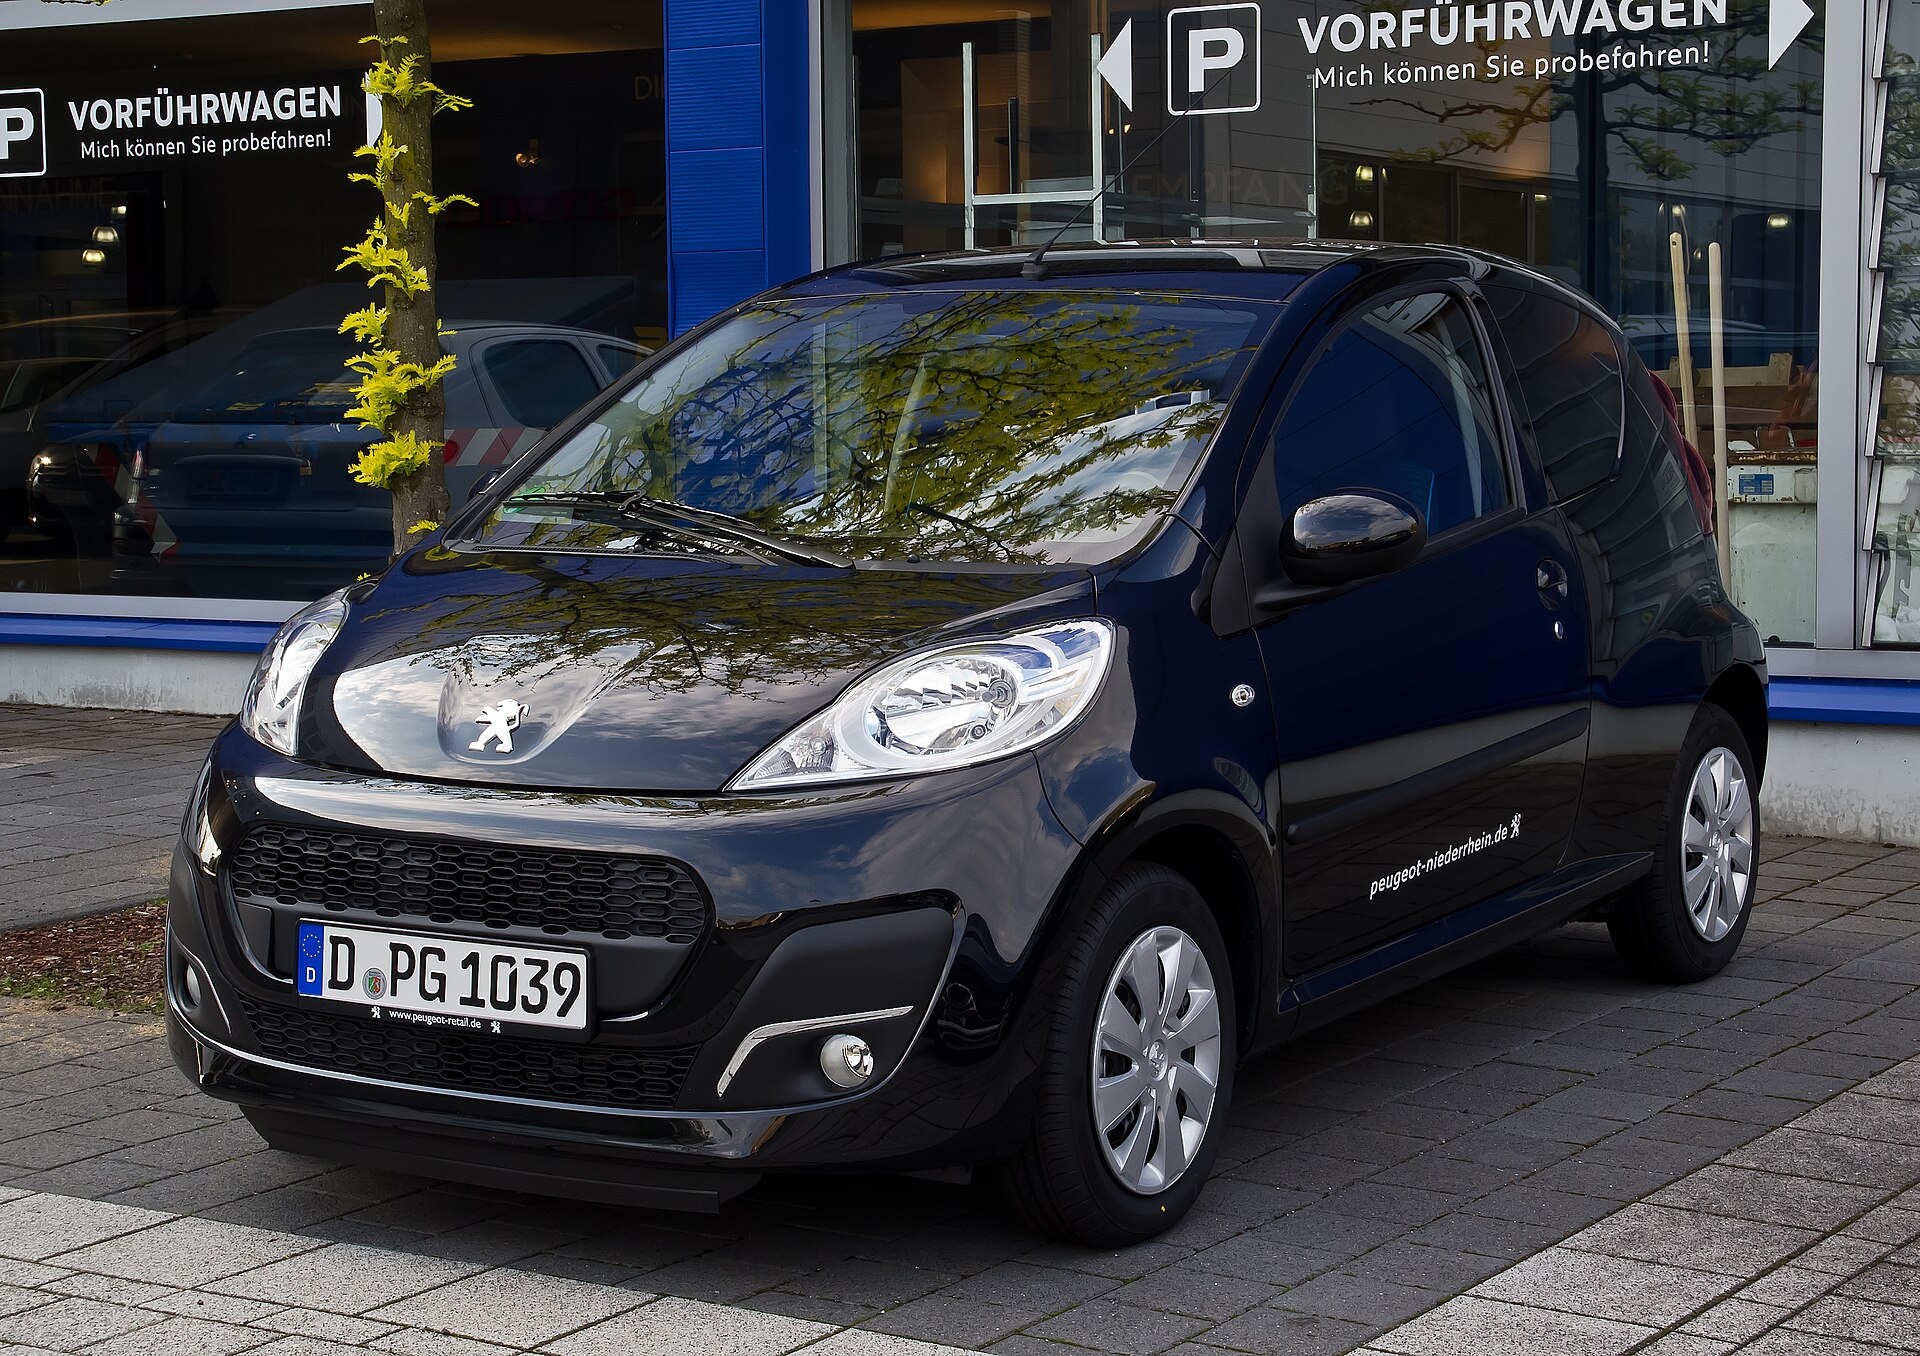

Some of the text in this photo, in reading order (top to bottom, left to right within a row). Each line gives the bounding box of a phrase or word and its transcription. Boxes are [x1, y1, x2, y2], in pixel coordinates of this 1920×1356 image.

[1297, 0, 1727, 54] VORFÜHRWAGEN
[1188, 27, 1244, 93] P
[1315, 40, 1709, 89] Mich können Sie probefahren!
[0, 107, 35, 160] P
[68, 86, 341, 131] VORFÜHRWAGEN
[81, 128, 331, 159] Mich können Sie probefahren!
[1369, 823, 1508, 900] peugeot-niederrhein.de
[306, 966, 316, 984] D
[328, 934, 355, 992] D
[389, 941, 447, 1003] PG
[459, 951, 582, 1018] 1039
[389, 1009, 482, 1030] www.peugeot-retail.de
